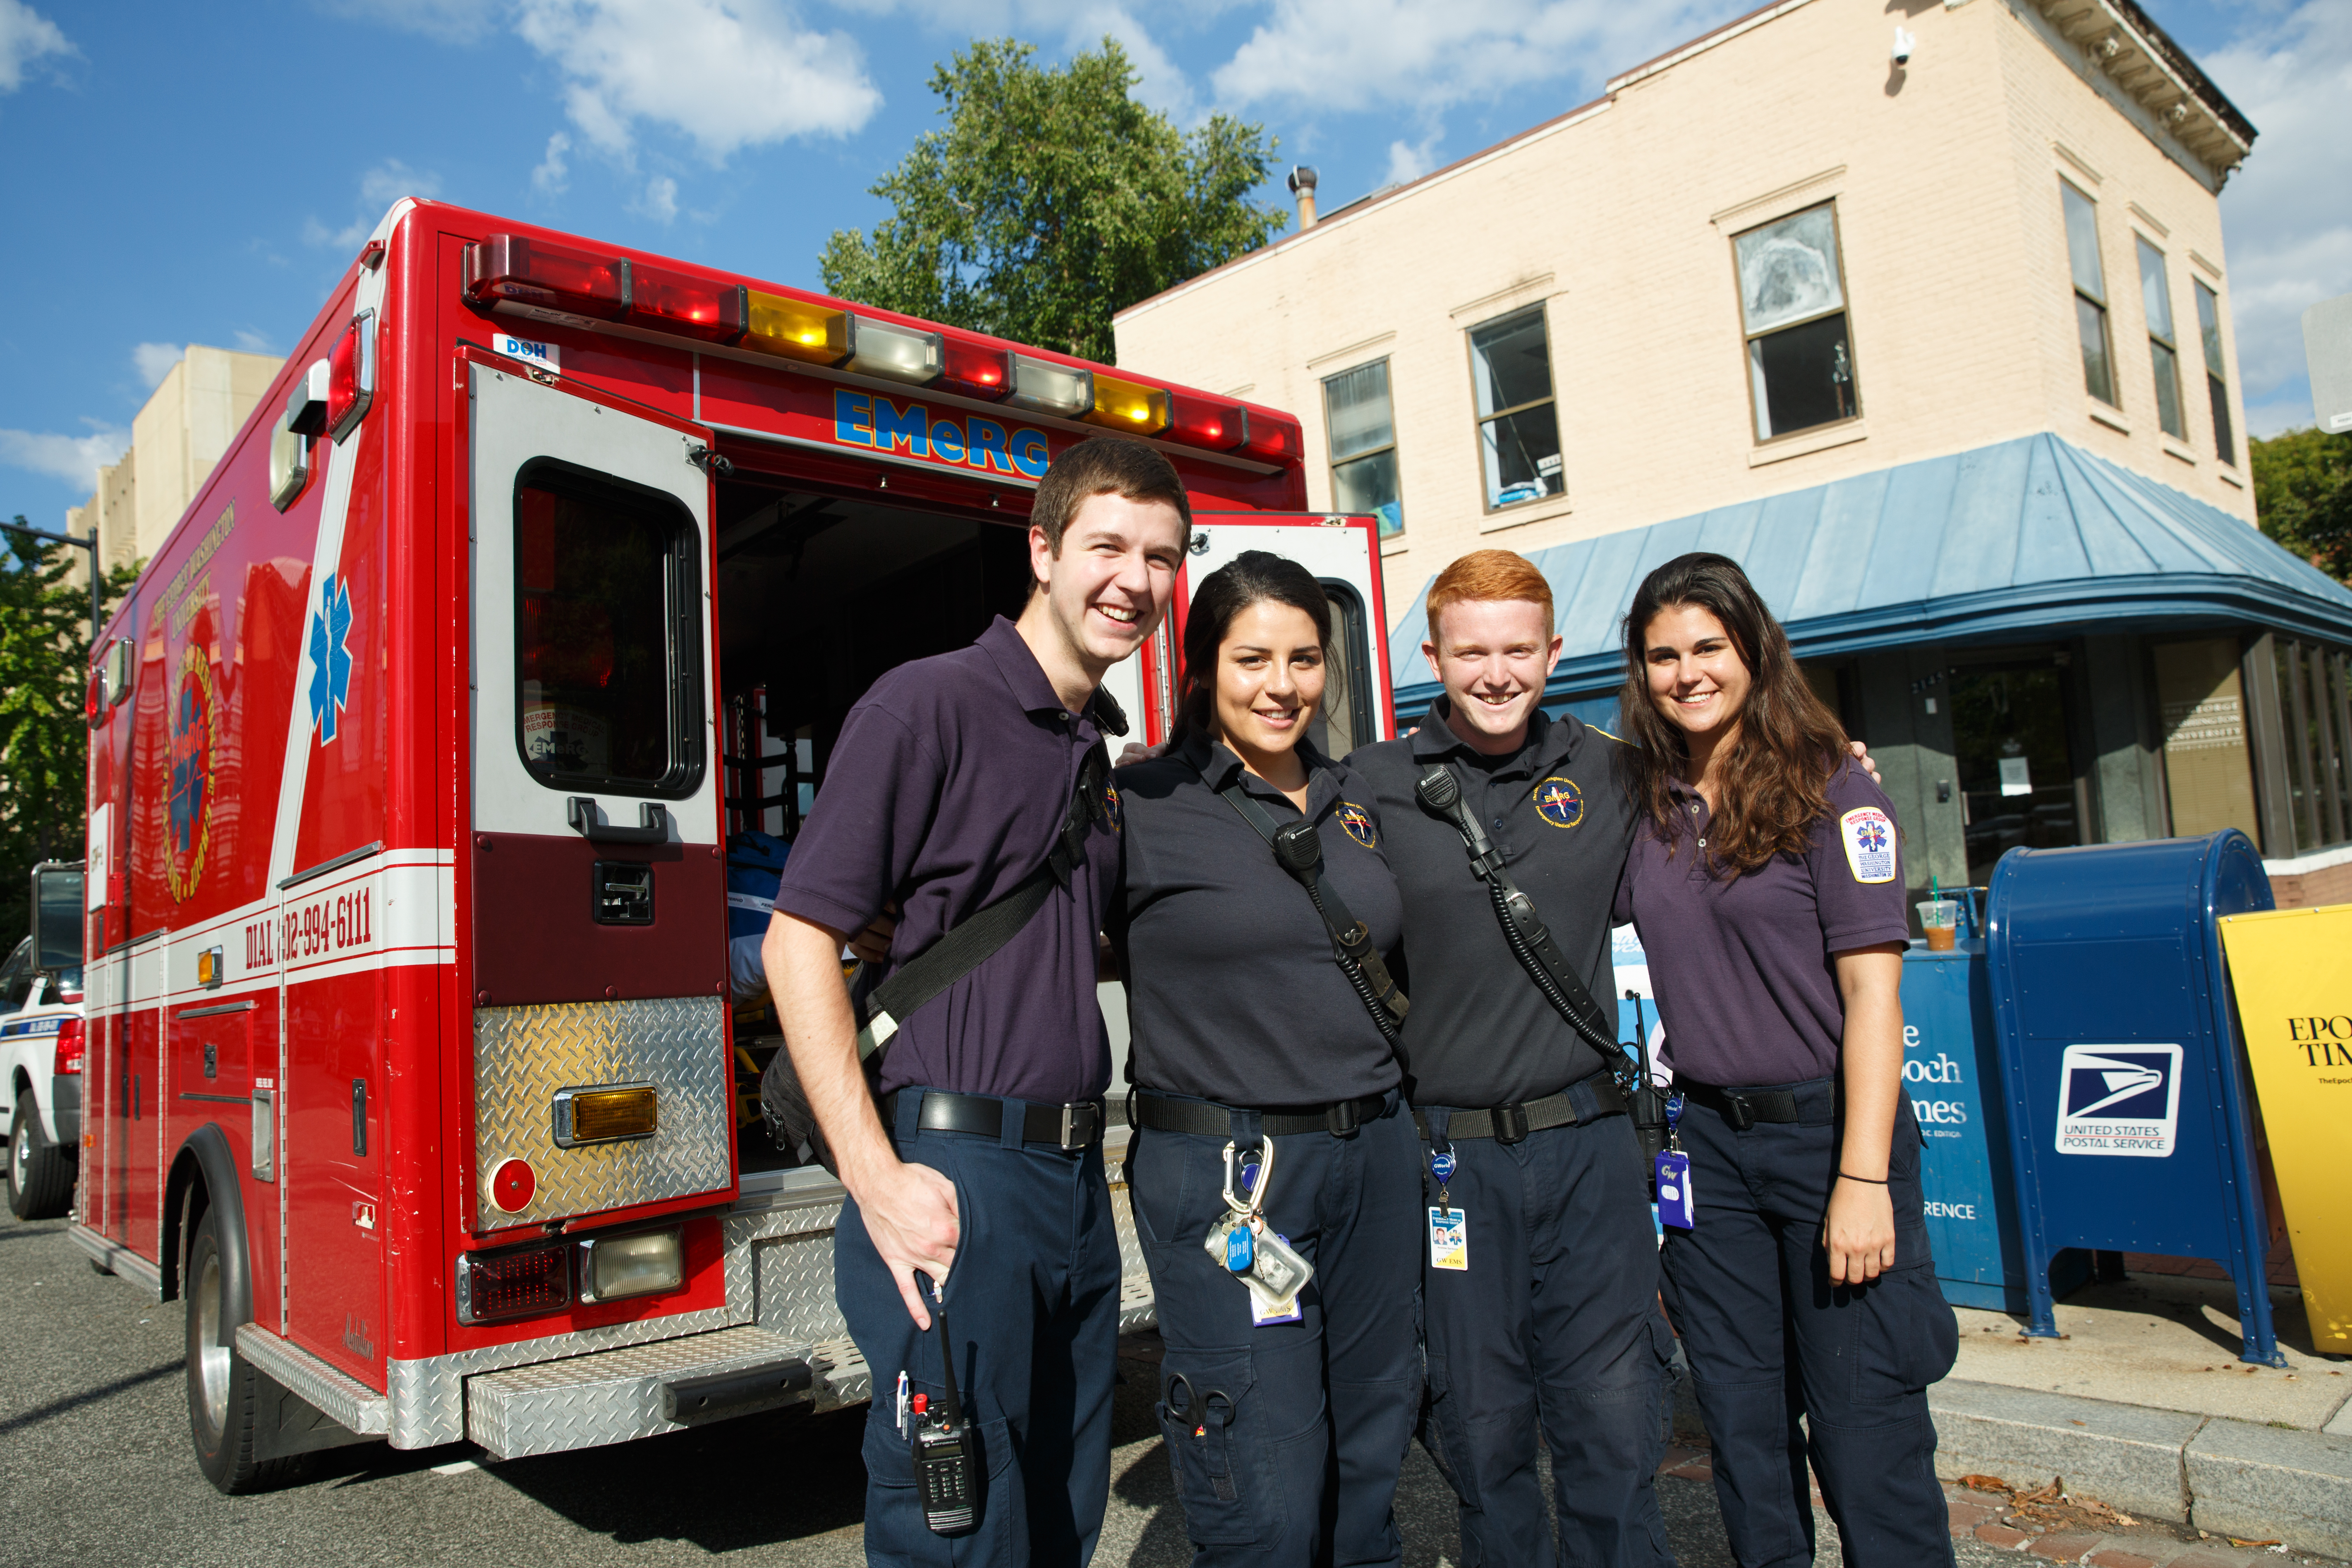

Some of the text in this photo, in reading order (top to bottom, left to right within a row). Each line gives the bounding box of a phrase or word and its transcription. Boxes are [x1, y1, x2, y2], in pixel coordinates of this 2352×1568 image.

[507, 339, 546, 359] DOH
[834, 387, 1050, 479] EMeRG
[190, 496, 235, 582] WASHINGTON
[172, 568, 211, 642] UNIVERSITY
[194, 642, 216, 796] RESPONSE
[524, 712, 568, 724] MERGENCY
[2165, 714, 2241, 729] WASHINGTON
[525, 721, 599, 737] RESPONSE GROUP
[2167, 727, 2241, 742] UNIVERSITY
[533, 742, 586, 756] EMeRG
[1564, 777, 1581, 795] University
[1535, 805, 1555, 826] Emergency
[1845, 812, 1887, 823] EMERGENCY MEDICAL
[1850, 816, 1872, 825] RESPONSE
[1296, 826, 1312, 836] MOTOROLA
[189, 802, 212, 900] GROUP
[246, 887, 371, 970] DIAL 02-994-6111
[1902, 1053, 1964, 1083] och
[2065, 1125, 2160, 1136] UNITED STATES
[2064, 1137, 2165, 1149] POSTAL SERVICE
[1923, 1201, 1976, 1220] RENCE
